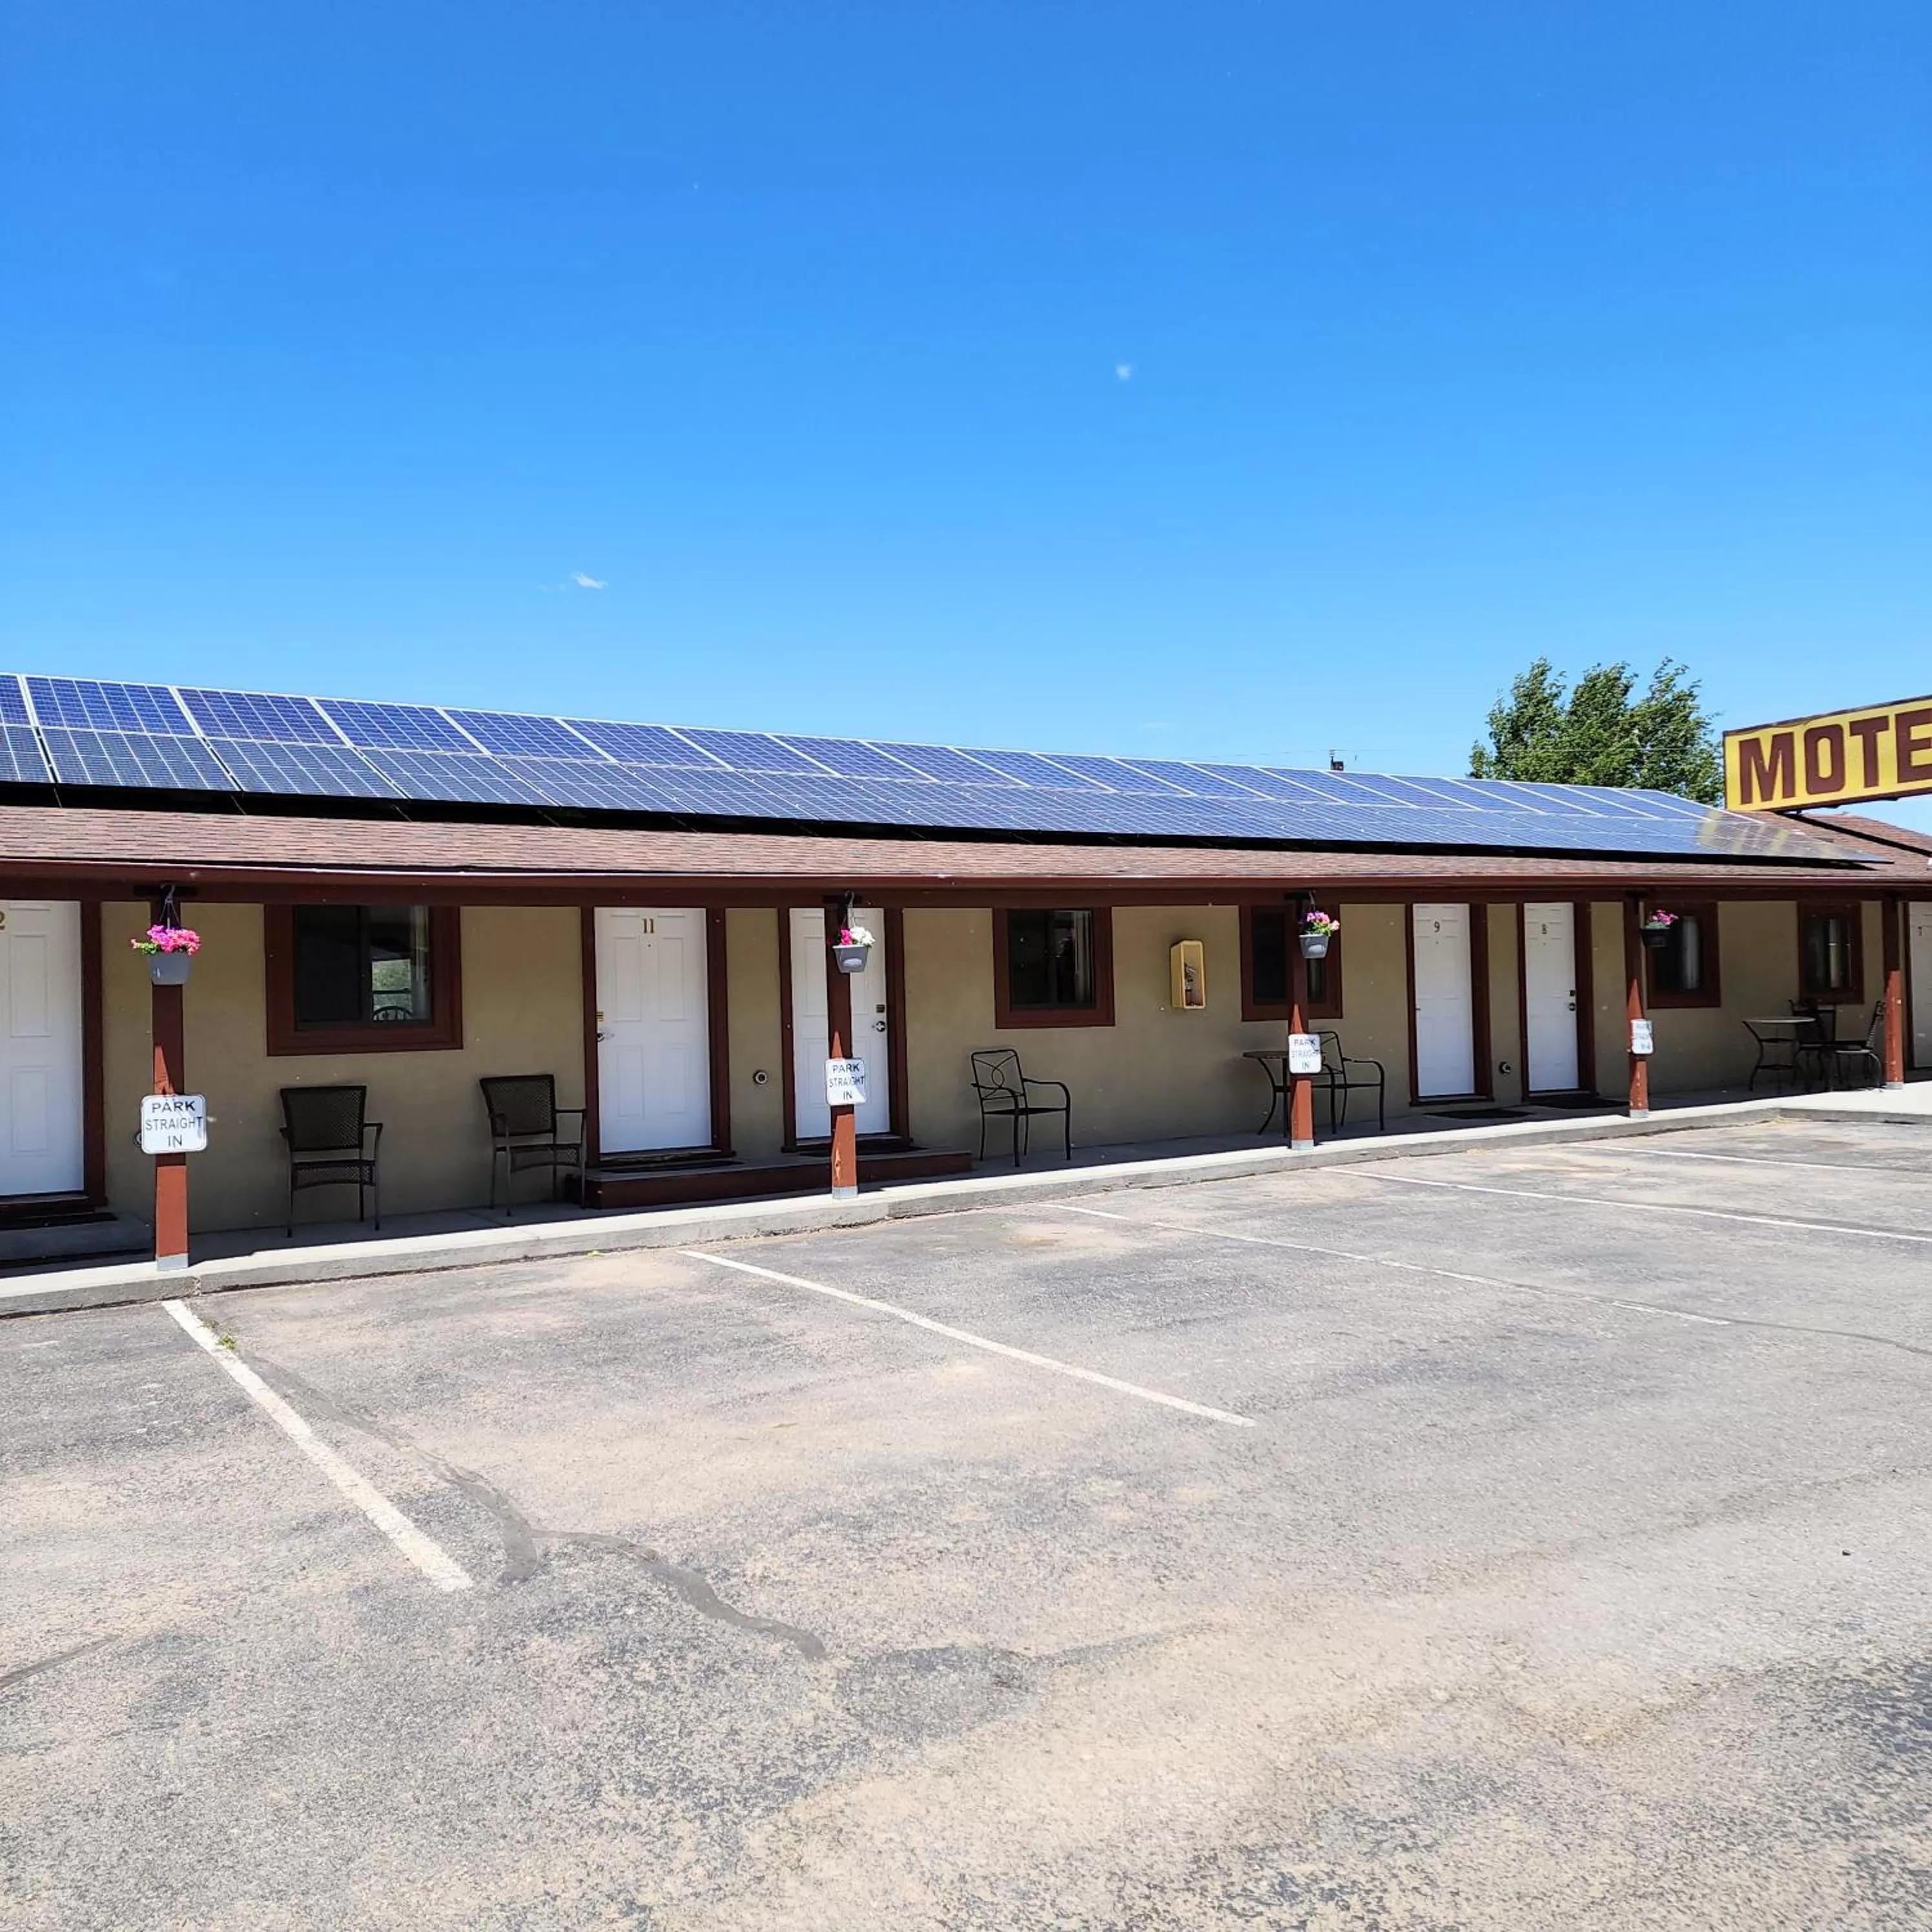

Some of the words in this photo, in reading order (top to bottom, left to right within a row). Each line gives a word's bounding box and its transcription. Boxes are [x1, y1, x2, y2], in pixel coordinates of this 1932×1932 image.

[642, 918, 654, 934] 11
[1434, 921, 1441, 933] 9
[832, 1063, 860, 1073] PARK
[828, 1075, 865, 1088] STRAIGHT
[843, 1090, 853, 1100] IN
[151, 1100, 196, 1114] PARK
[145, 1116, 203, 1131] STRAIGHT
[167, 1135, 183, 1148] IN
